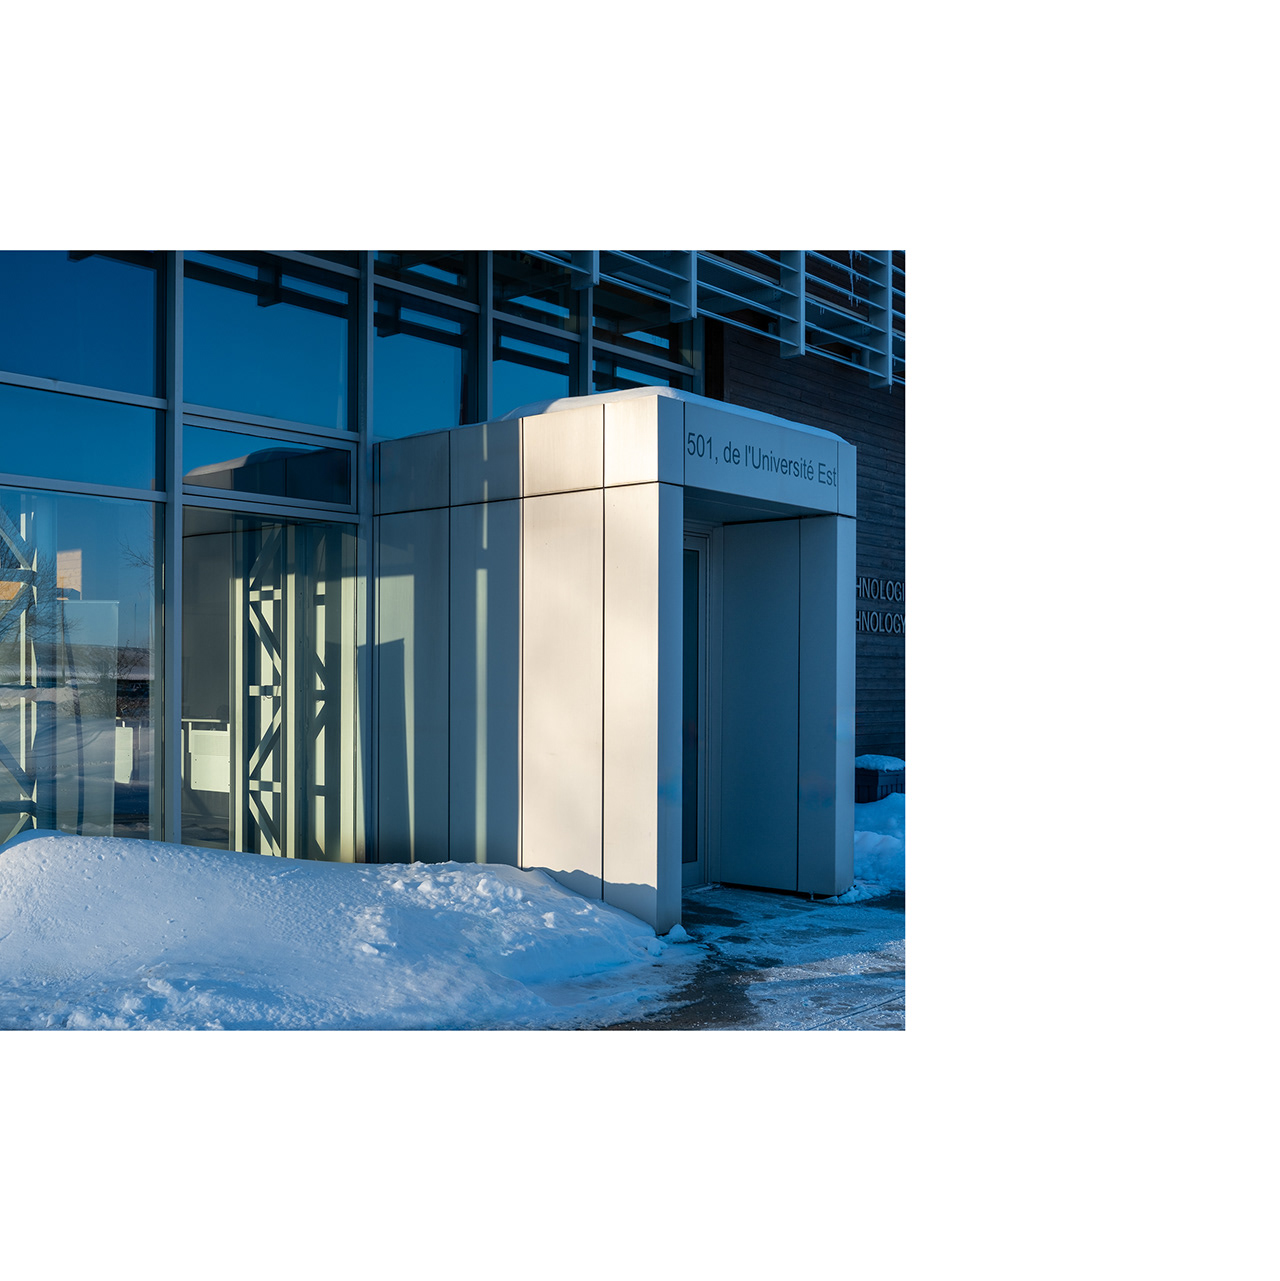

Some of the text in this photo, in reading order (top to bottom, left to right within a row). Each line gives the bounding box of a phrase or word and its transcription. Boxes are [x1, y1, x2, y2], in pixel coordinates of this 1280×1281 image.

[687, 432, 837, 487] 501, de l'Université Est
